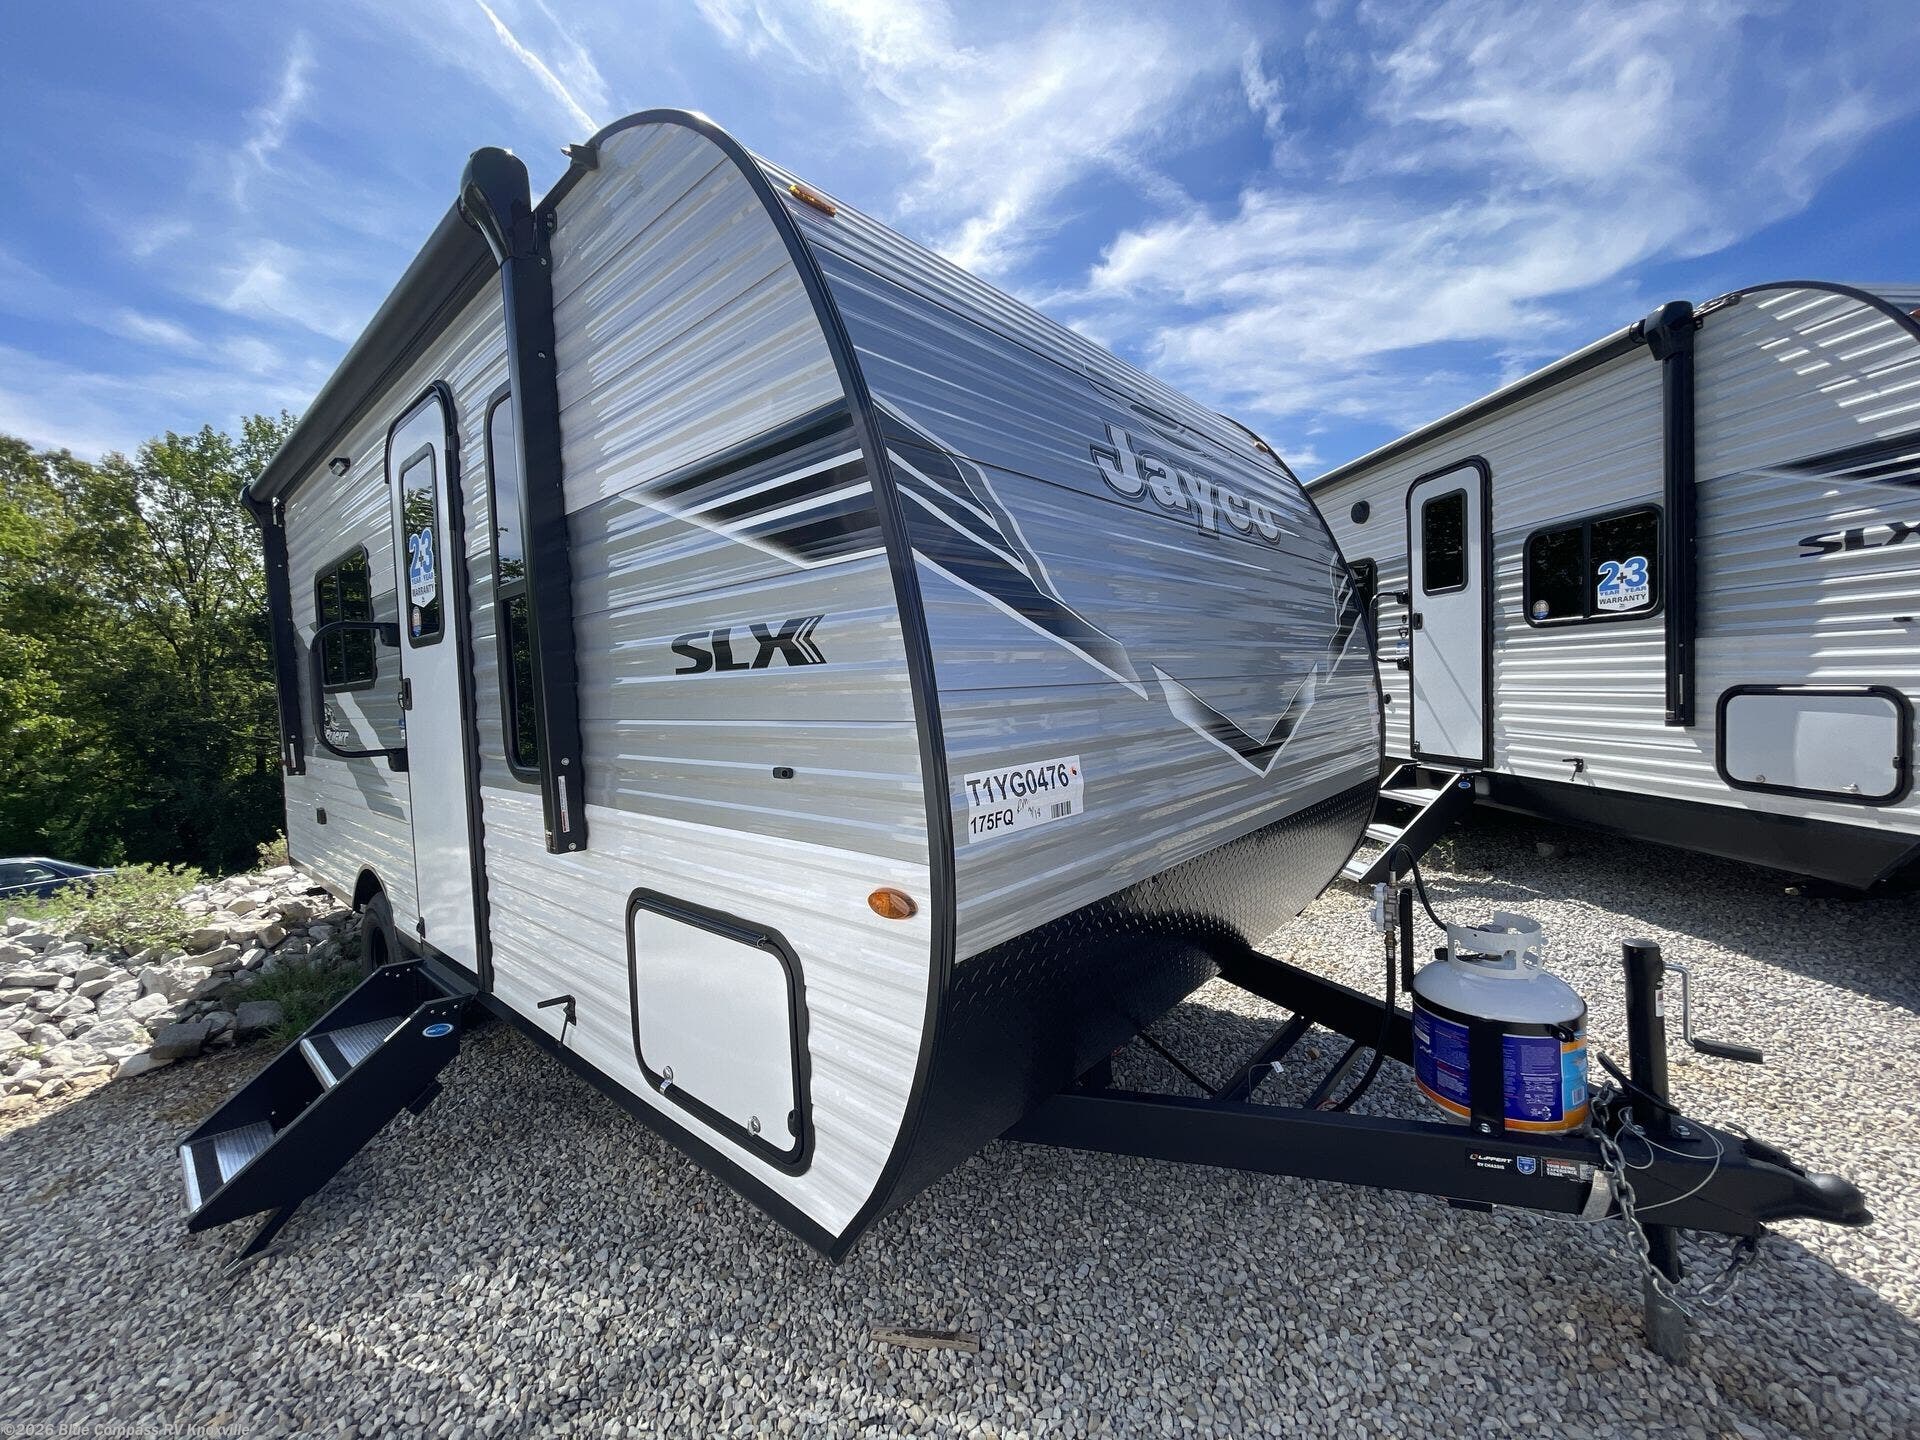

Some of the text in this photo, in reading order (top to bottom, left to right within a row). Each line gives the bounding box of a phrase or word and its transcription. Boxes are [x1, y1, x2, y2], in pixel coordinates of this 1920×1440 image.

[1091, 423, 1281, 544] Jayco
[412, 584, 434, 597] WARRANTY
[1600, 593, 1646, 604] WARRANTY
[671, 614, 827, 675] SLX
[966, 763, 1070, 806] T1YG0476
[970, 808, 1014, 834] 175FQ
